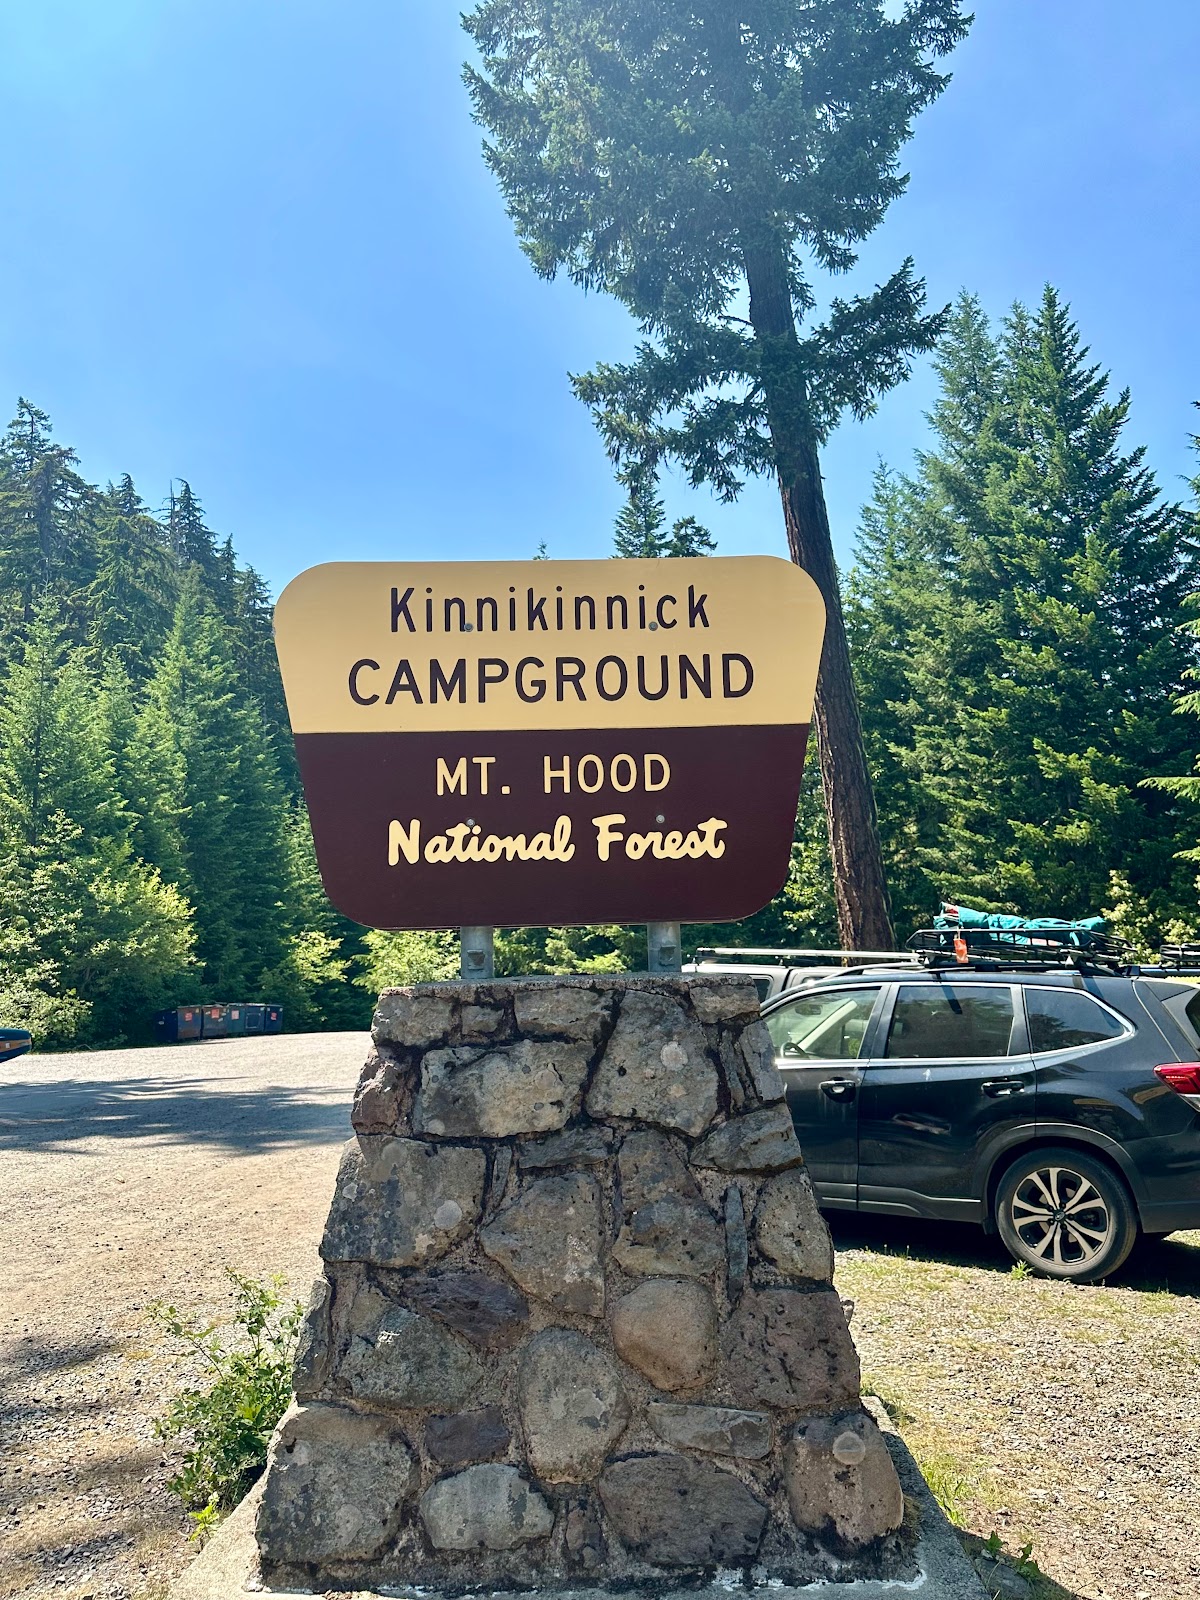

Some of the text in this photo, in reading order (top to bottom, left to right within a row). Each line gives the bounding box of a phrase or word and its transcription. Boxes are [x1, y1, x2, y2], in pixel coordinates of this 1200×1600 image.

[391, 584, 710, 633] Kinnikinnick
[348, 653, 755, 706] CAMPGROUND
[436, 753, 671, 796] MT. HOOD
[388, 813, 728, 866] National Forest
